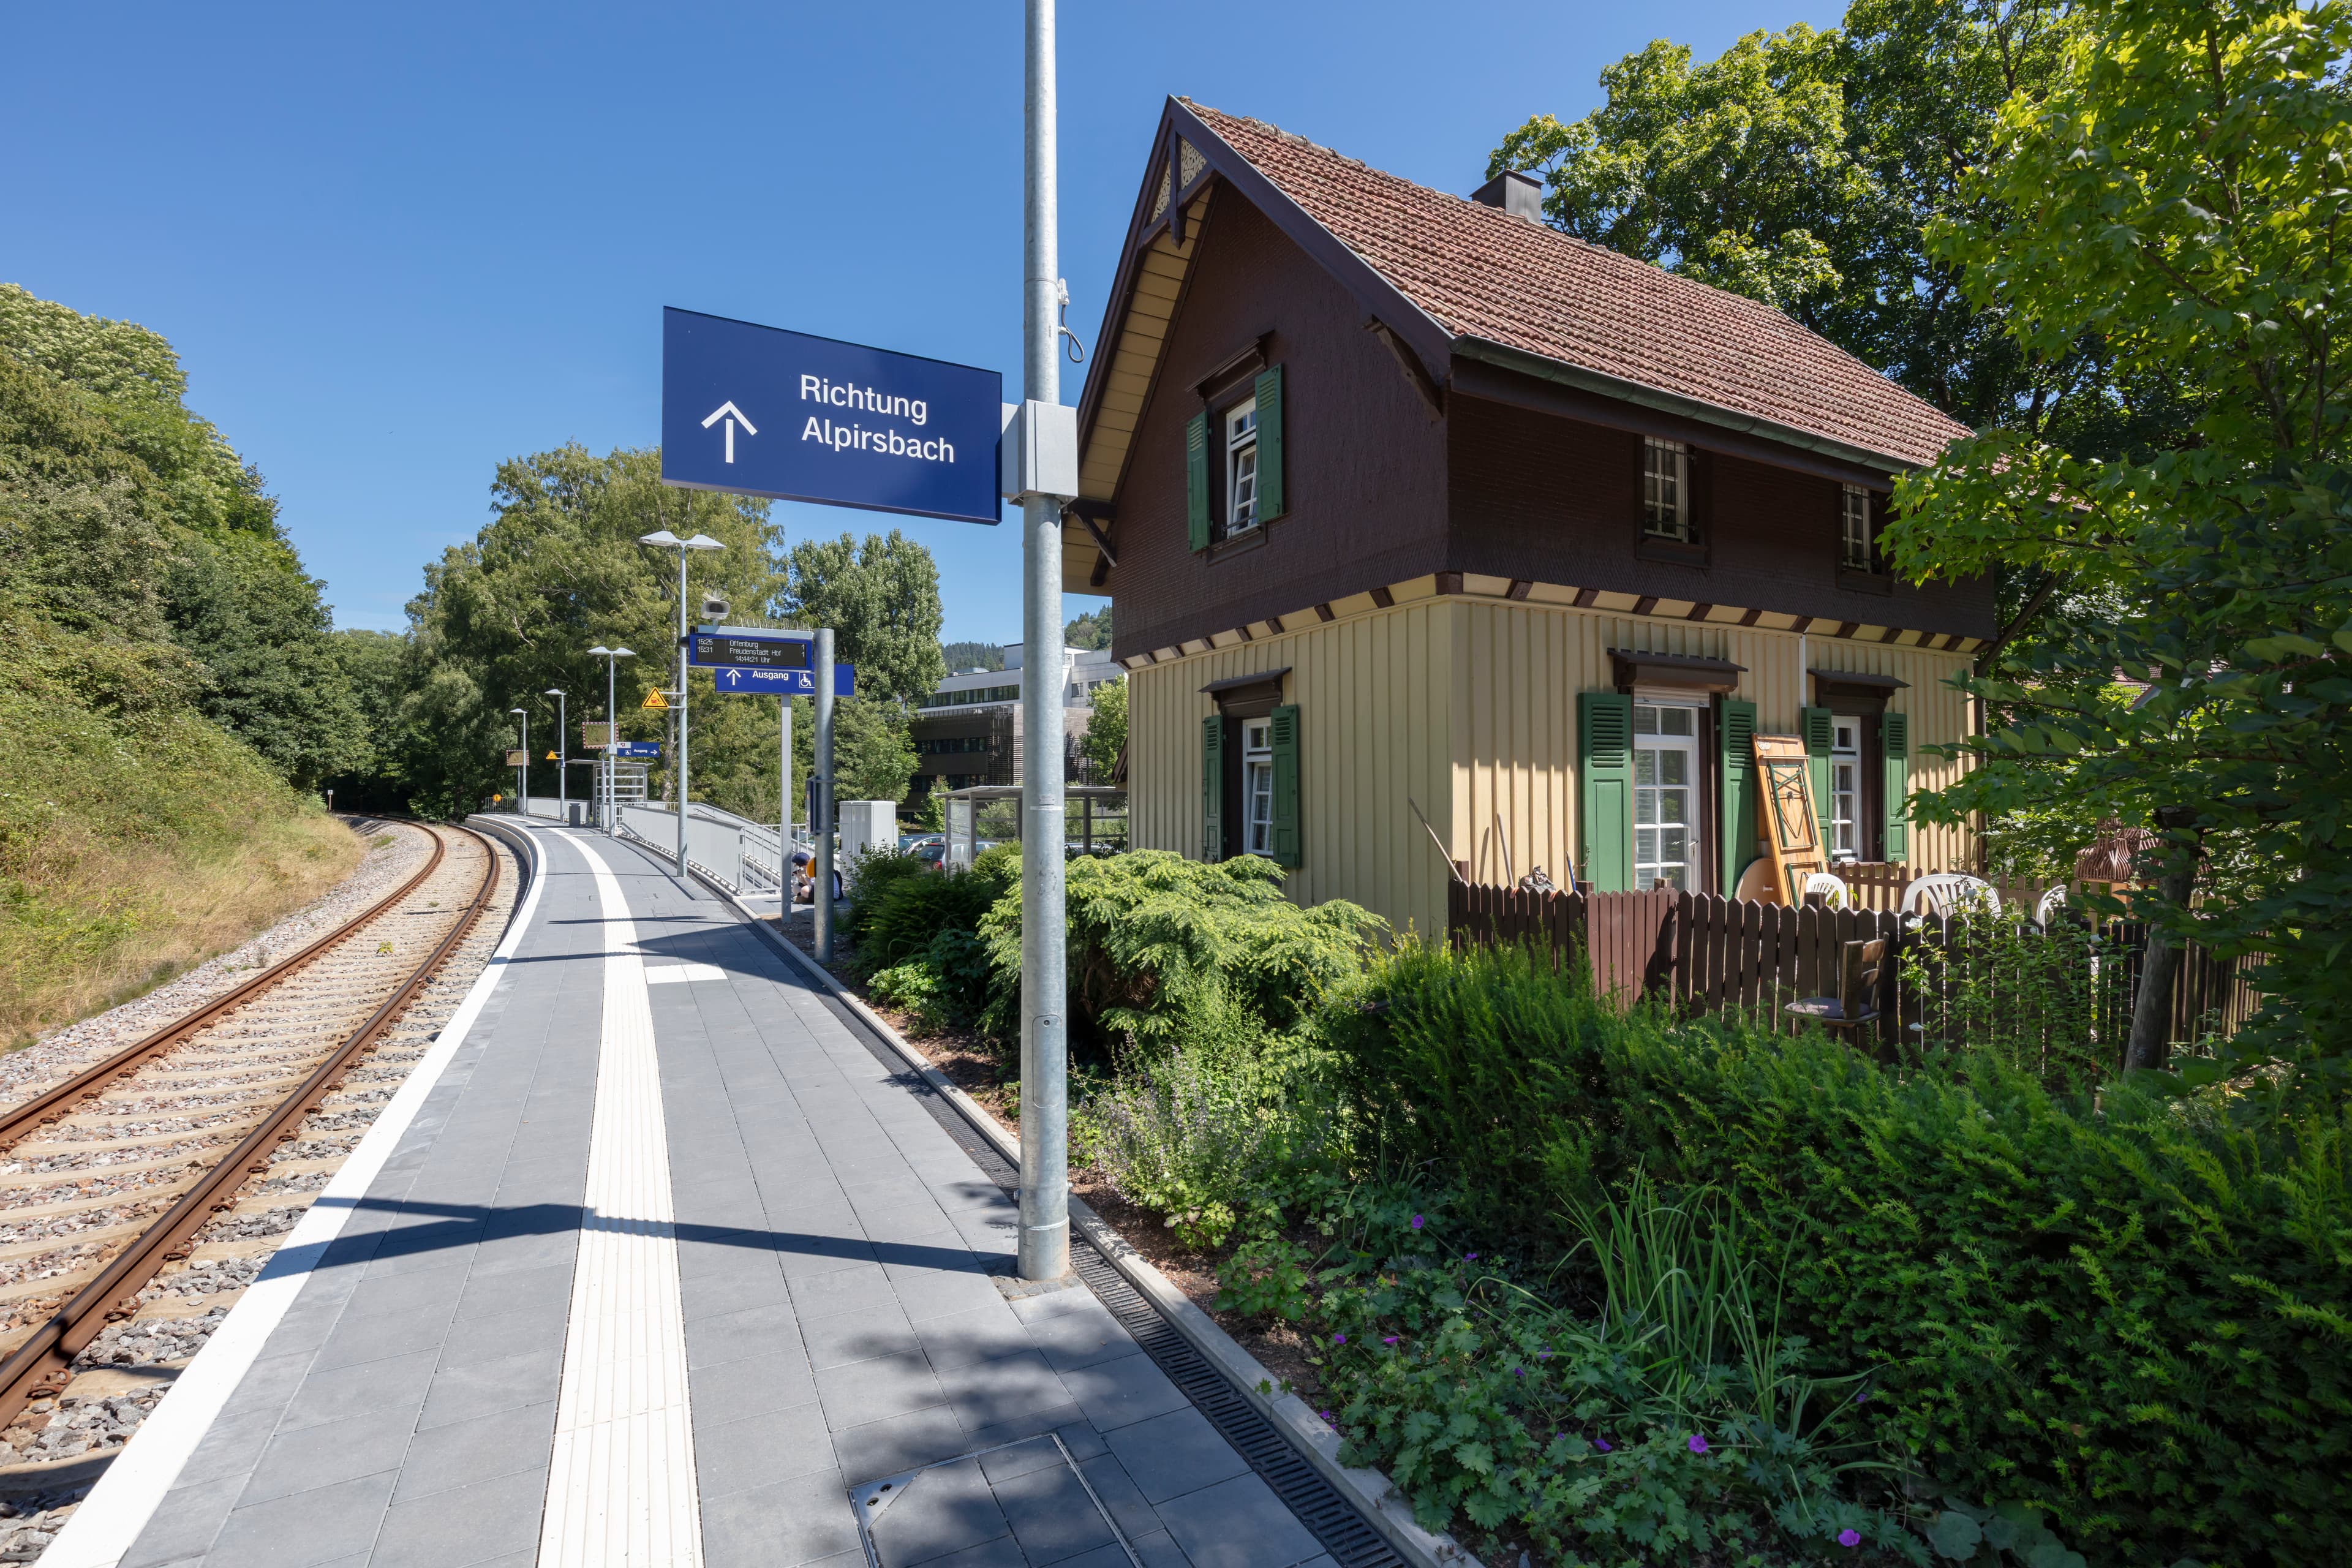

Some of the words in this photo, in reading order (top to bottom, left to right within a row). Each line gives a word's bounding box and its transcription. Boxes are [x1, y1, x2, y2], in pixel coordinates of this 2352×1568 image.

[801, 374, 927, 426] Richtung
[801, 416, 954, 463] Alpirsbach
[729, 640, 759, 649] Offenburg
[729, 647, 769, 656] Freudenstadt
[752, 670, 790, 681] Ausgang
